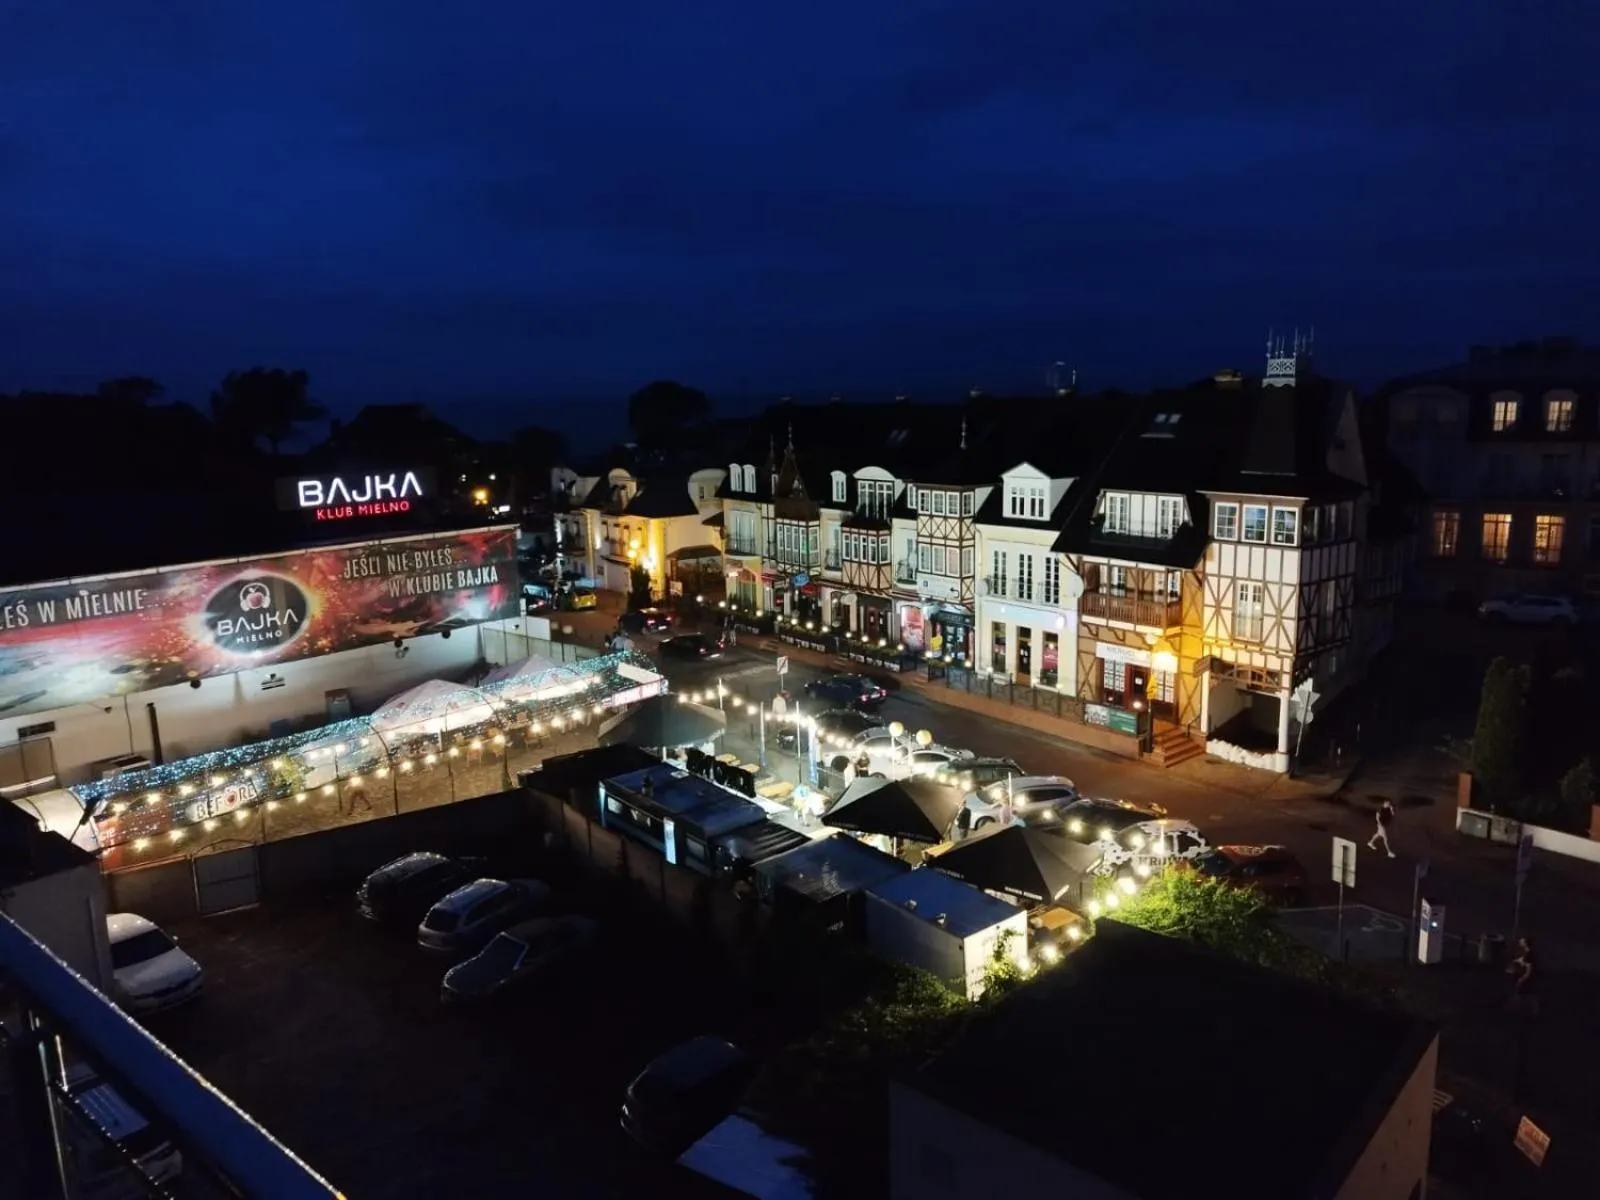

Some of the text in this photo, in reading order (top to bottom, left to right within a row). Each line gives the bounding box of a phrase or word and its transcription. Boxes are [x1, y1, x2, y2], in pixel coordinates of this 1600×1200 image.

[298, 471, 422, 507] BAJKA
[317, 501, 410, 520] KLUB MIELNO
[344, 553, 380, 579] JEŚLI
[387, 553, 409, 574] NIE
[388, 565, 498, 598] W KLUBIE BAJKA
[0, 600, 29, 629] EŚ
[37, 600, 56, 623] W
[217, 608, 299, 636] BAJKA
[236, 631, 283, 644] MIELNO
